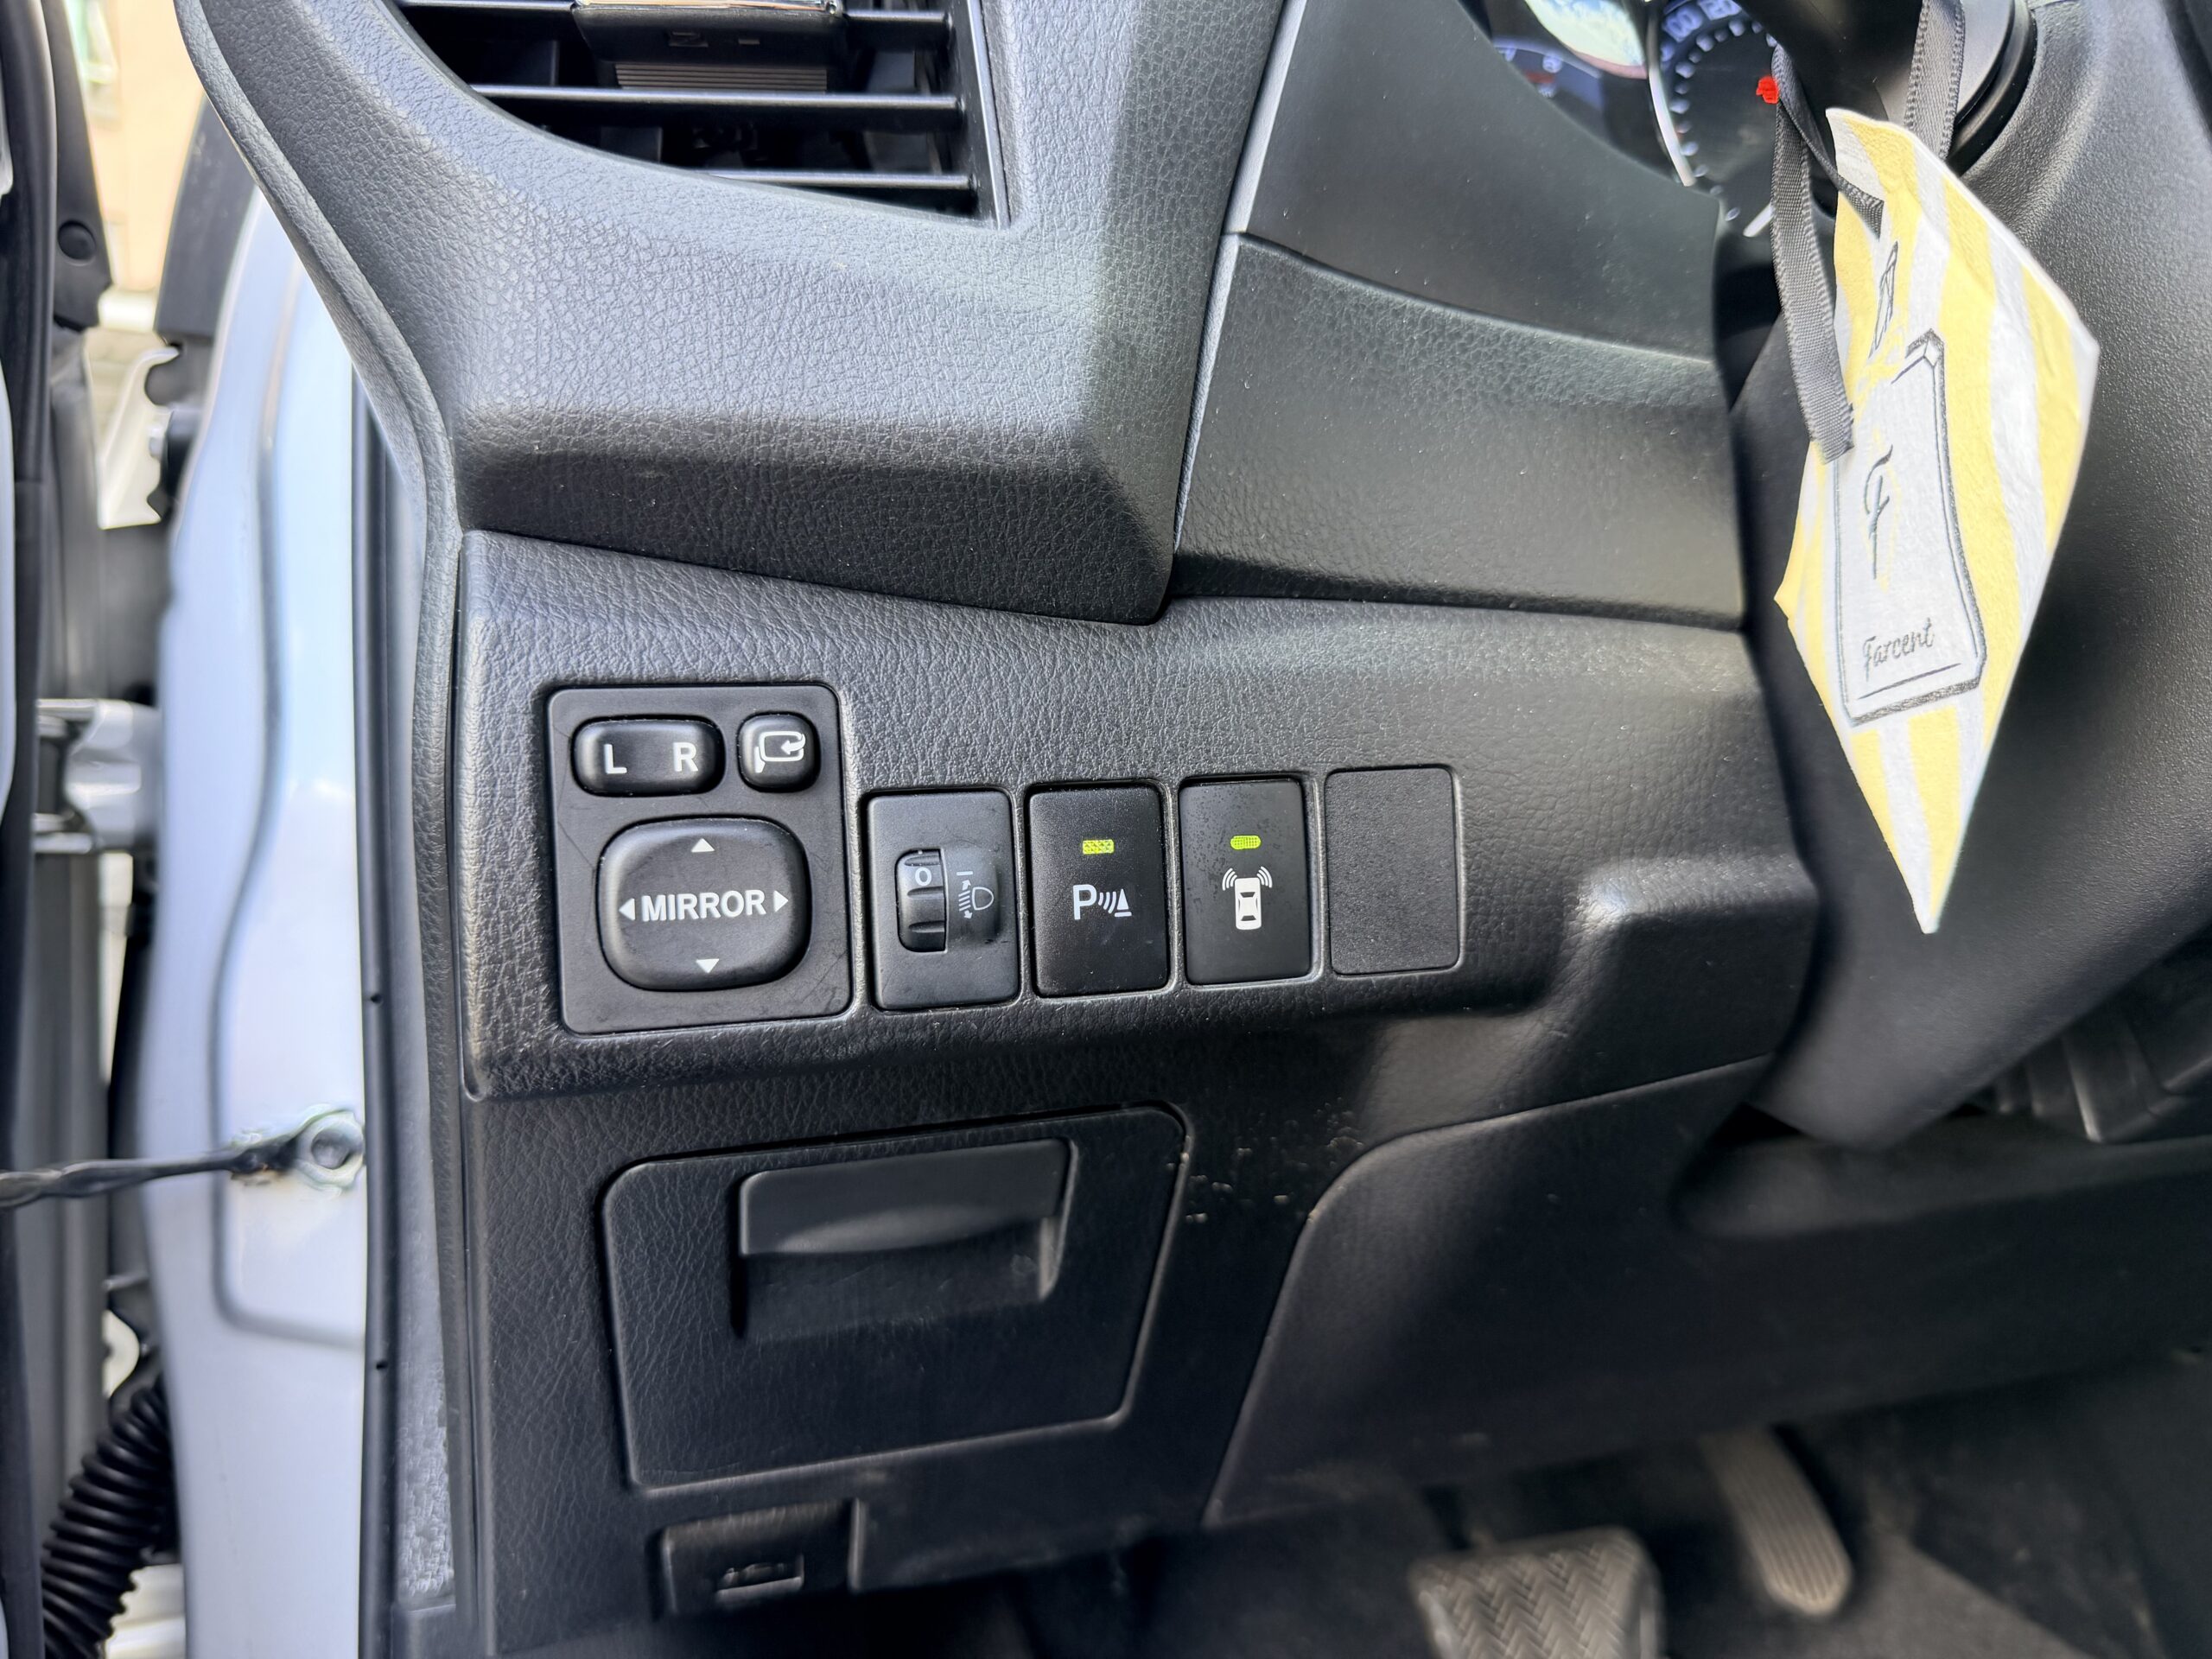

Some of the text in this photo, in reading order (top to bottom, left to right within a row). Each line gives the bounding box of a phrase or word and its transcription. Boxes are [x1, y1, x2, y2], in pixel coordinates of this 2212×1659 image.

[1862, 616, 1935, 683] Farcent
[605, 741, 699, 775] L R
[641, 889, 767, 922] MIRROR
[1072, 883, 1097, 920] P
